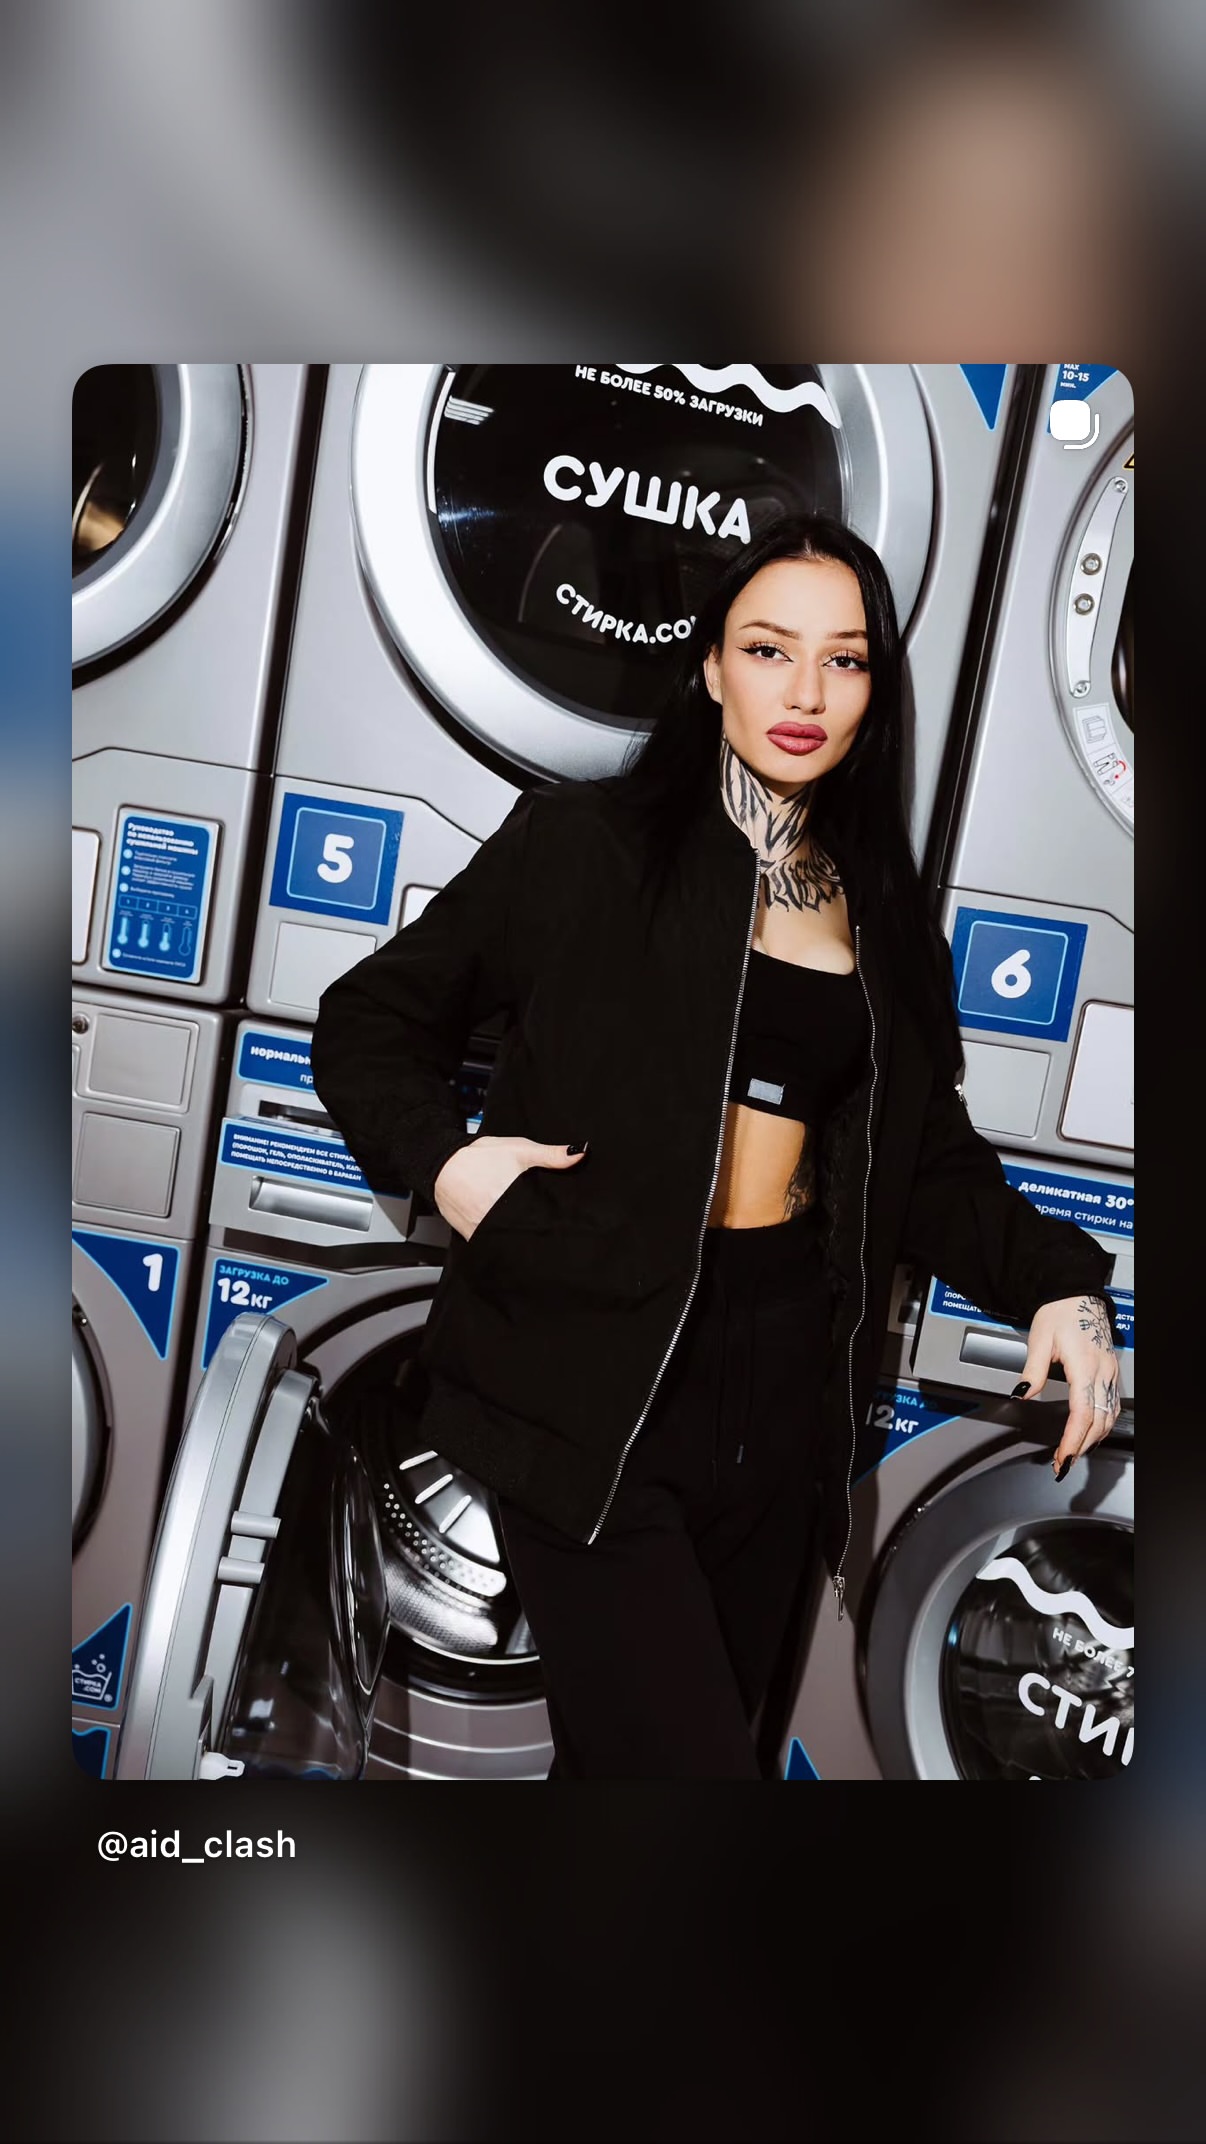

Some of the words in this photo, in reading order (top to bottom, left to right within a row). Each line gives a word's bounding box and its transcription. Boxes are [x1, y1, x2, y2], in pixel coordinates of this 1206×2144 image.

[1062, 370, 1090, 382] 10-15
[575, 365, 597, 381] НЕ
[600, 371, 651, 396] БОЛЕЕ
[654, 385, 686, 405] 50%
[690, 395, 764, 427] ЗАГРУЗКИ
[543, 455, 751, 545] СУШКА
[556, 583, 696, 643] СТИРКА.СО
[317, 833, 354, 884] 5
[991, 949, 1031, 999] 6
[233, 1133, 269, 1146] ВНИМАНИЕ!
[316, 1148, 329, 1157] ВСЕ
[231, 1151, 265, 1163] ПОМЕЩАТЬ
[333, 1169, 362, 1181] БАРАБАН
[1018, 1181, 1102, 1205] деликатная
[1074, 1211, 1116, 1226] стирки
[143, 1253, 163, 1292] 1
[219, 1264, 271, 1283] ЗАГРУЗКА
[271, 1274, 290, 1286] ДО
[1053, 1627, 1073, 1646] НЕ
[1074, 1640, 1124, 1673] БОЛЕЕ
